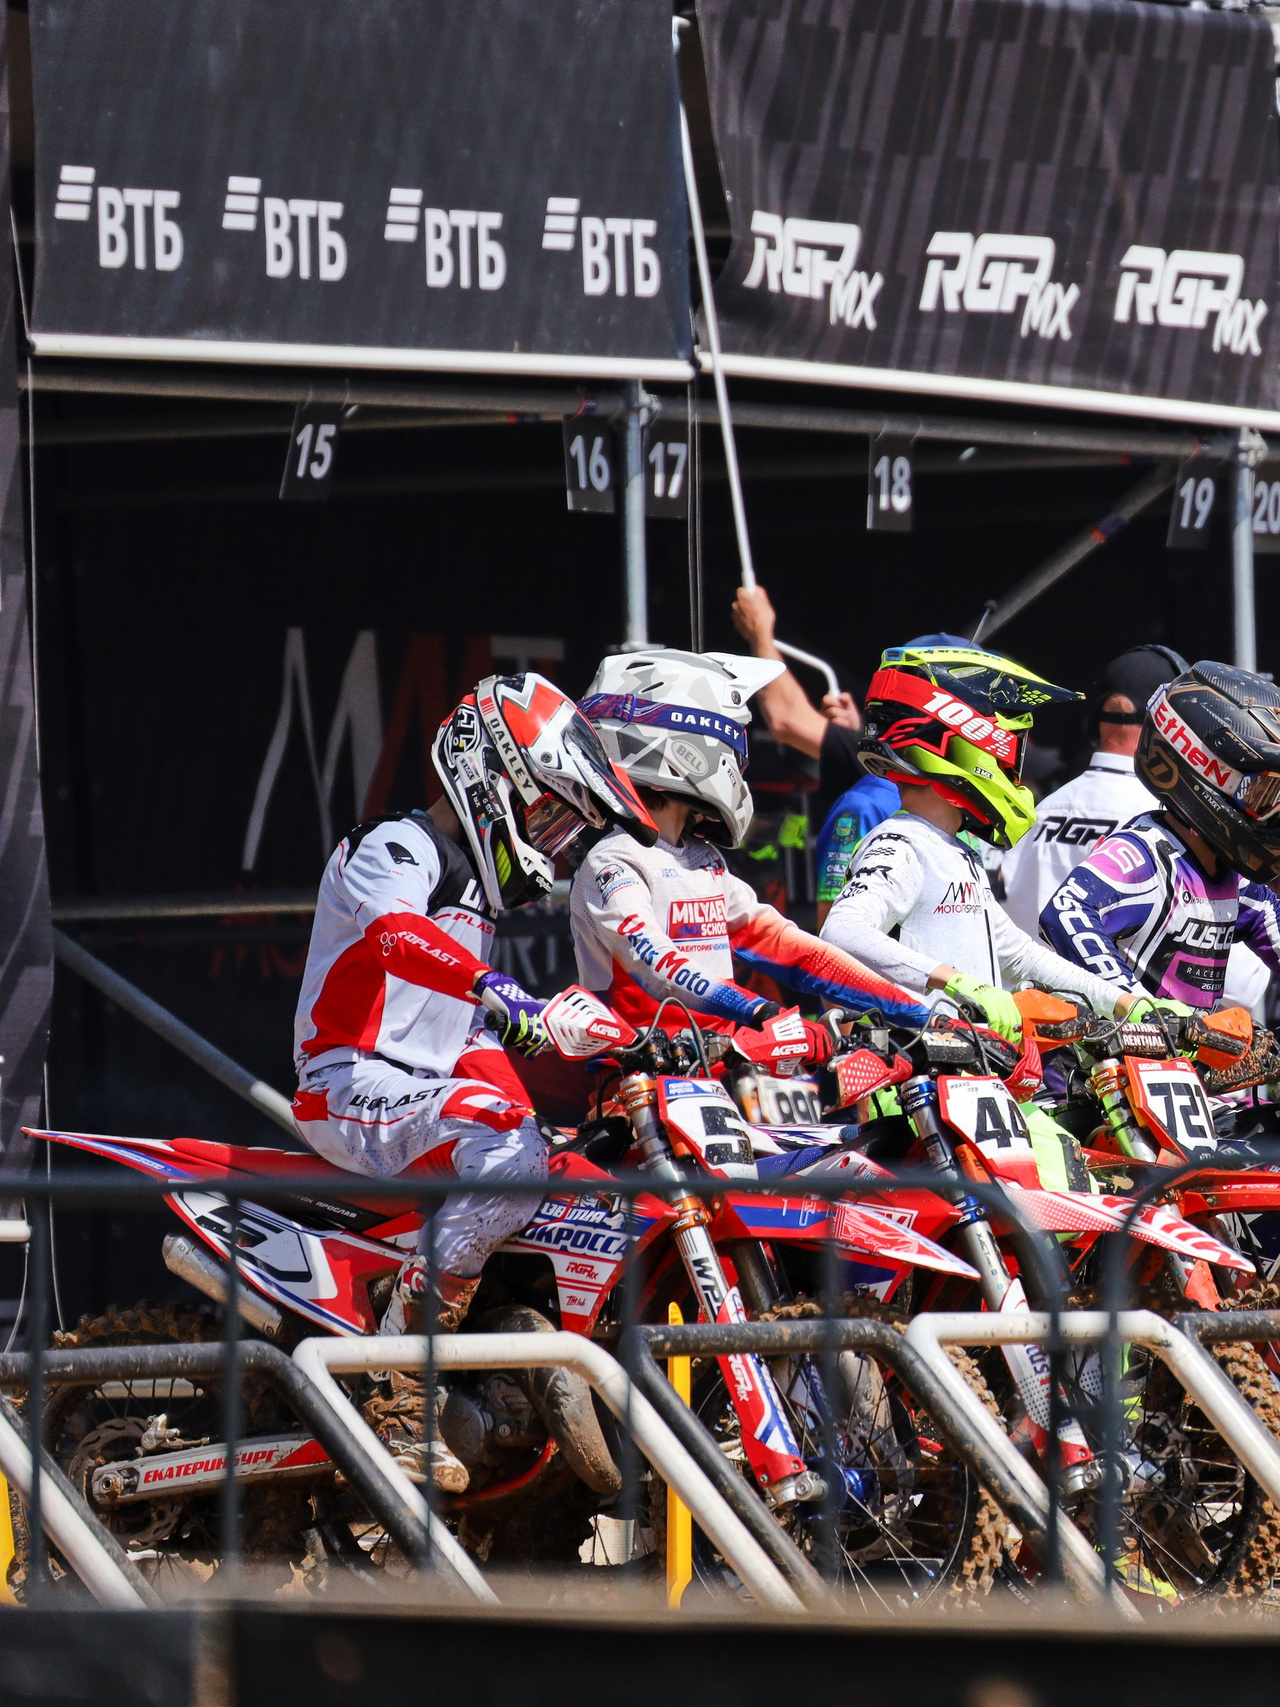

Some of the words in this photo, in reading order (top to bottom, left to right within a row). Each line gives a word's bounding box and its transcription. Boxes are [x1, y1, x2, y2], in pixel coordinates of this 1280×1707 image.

[98, 186, 184, 271] ВТБ
[264, 197, 348, 281] ВТБ
[425, 208, 507, 291] ВТБ
[581, 217, 661, 298] ВТБ
[295, 423, 336, 479] 15
[569, 435, 609, 491] 16
[649, 442, 688, 499] 17
[874, 455, 911, 513] 18
[1178, 477, 1214, 529] 19
[670, 711, 740, 741] OAKLEY
[922, 691, 1014, 758] 100%
[489, 717, 534, 790] OAKLEY
[675, 743, 705, 772] BELL
[453, 912, 496, 935] PLAS
[676, 943, 712, 953] РАЕКТОРИЯ
[654, 950, 710, 997] Moto
[1123, 1034, 1167, 1047] RENTHAL
[316, 1201, 357, 1218] ЯРОСЛАВ
